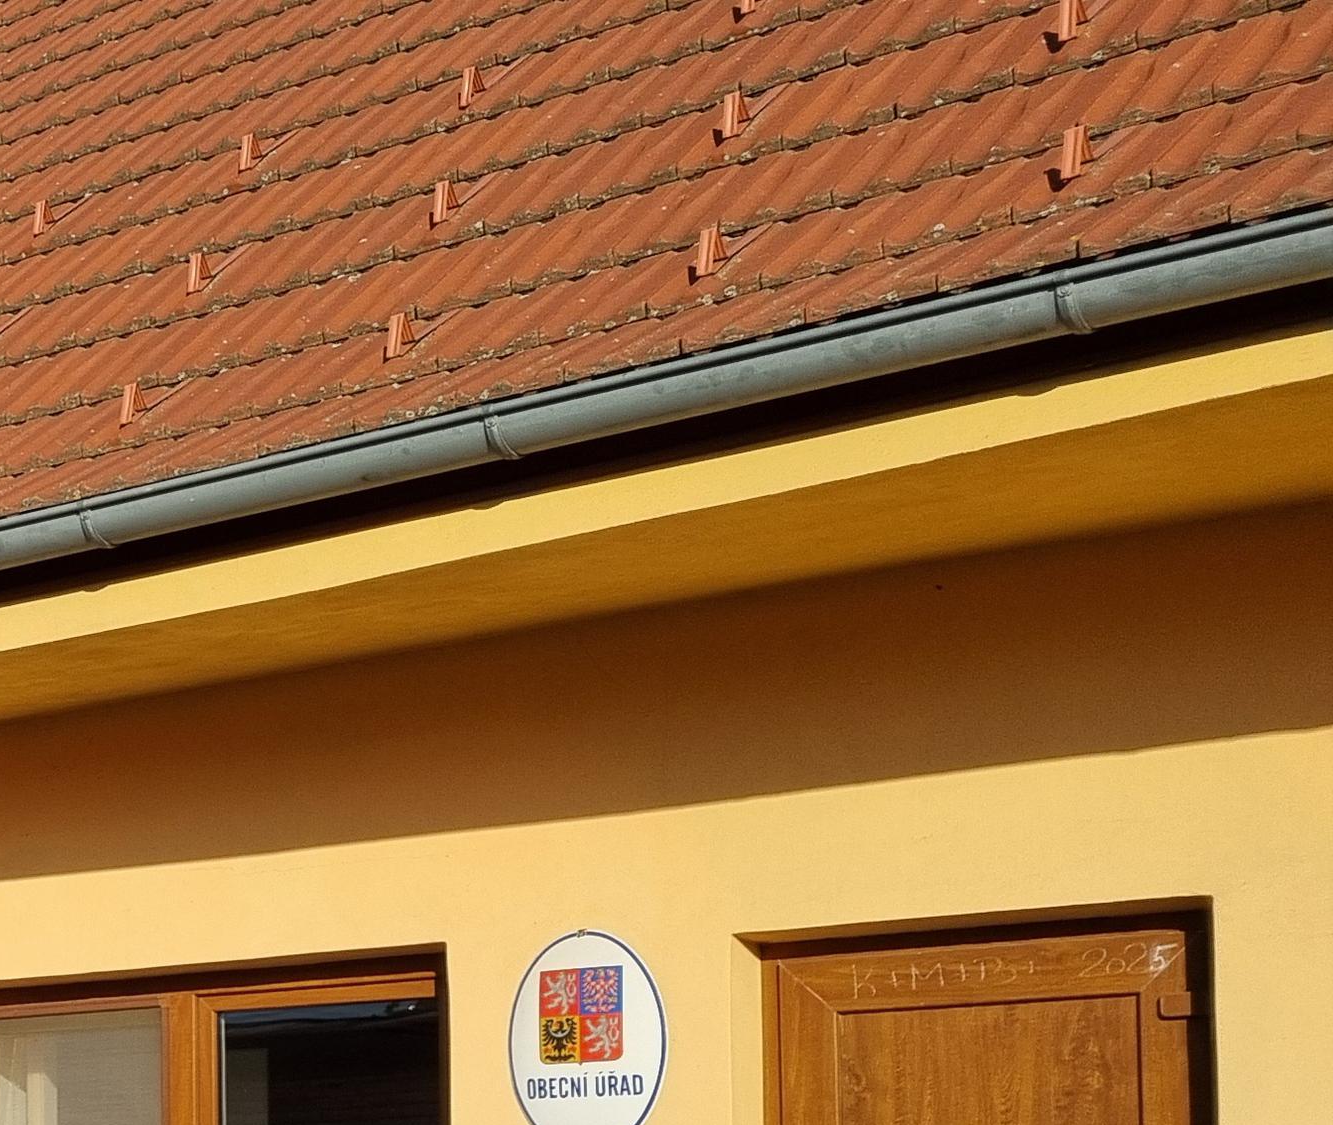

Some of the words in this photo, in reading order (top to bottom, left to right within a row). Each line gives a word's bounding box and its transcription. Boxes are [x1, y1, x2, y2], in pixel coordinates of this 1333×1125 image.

[1078, 943, 1179, 978] 2025
[526, 1072, 588, 1100] OBECNÍ
[595, 1071, 645, 1098] ÚŘAD
